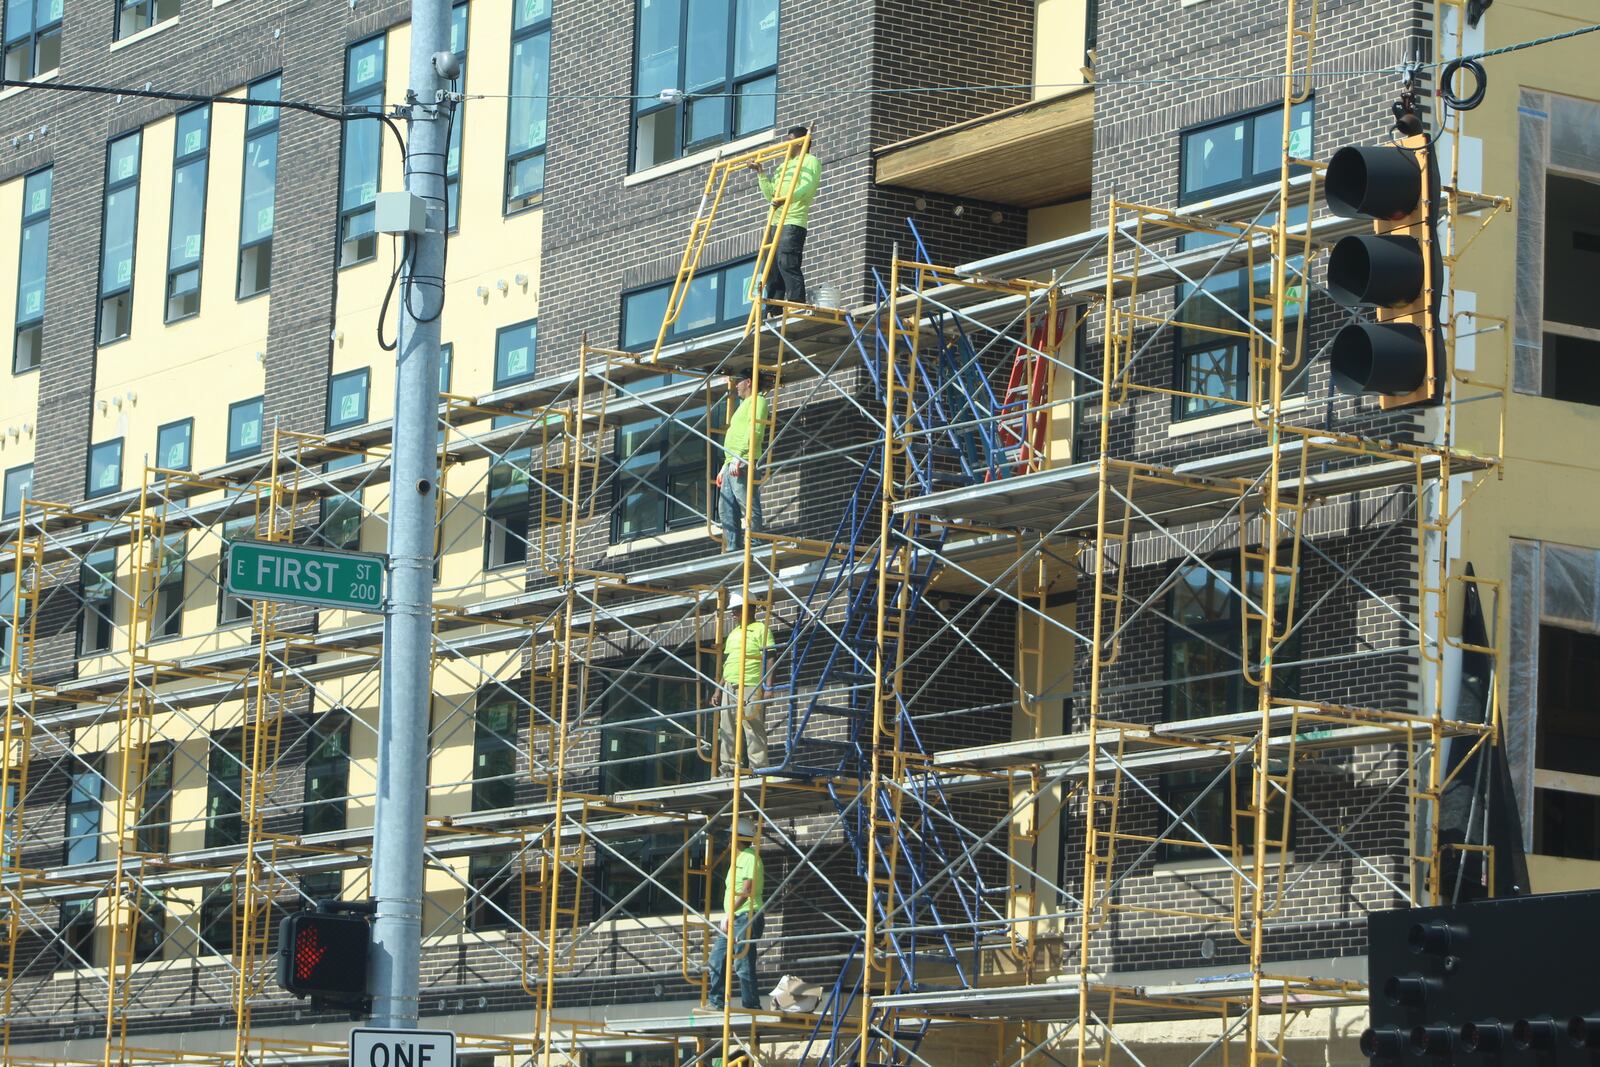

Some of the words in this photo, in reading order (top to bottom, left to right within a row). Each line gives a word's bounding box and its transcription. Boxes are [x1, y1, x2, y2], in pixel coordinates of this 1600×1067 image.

[237, 560, 245, 576] E
[257, 554, 340, 594] FIRST
[356, 564, 371, 580] ST
[350, 582, 376, 601] 200
[370, 1042, 435, 1067] ONE
